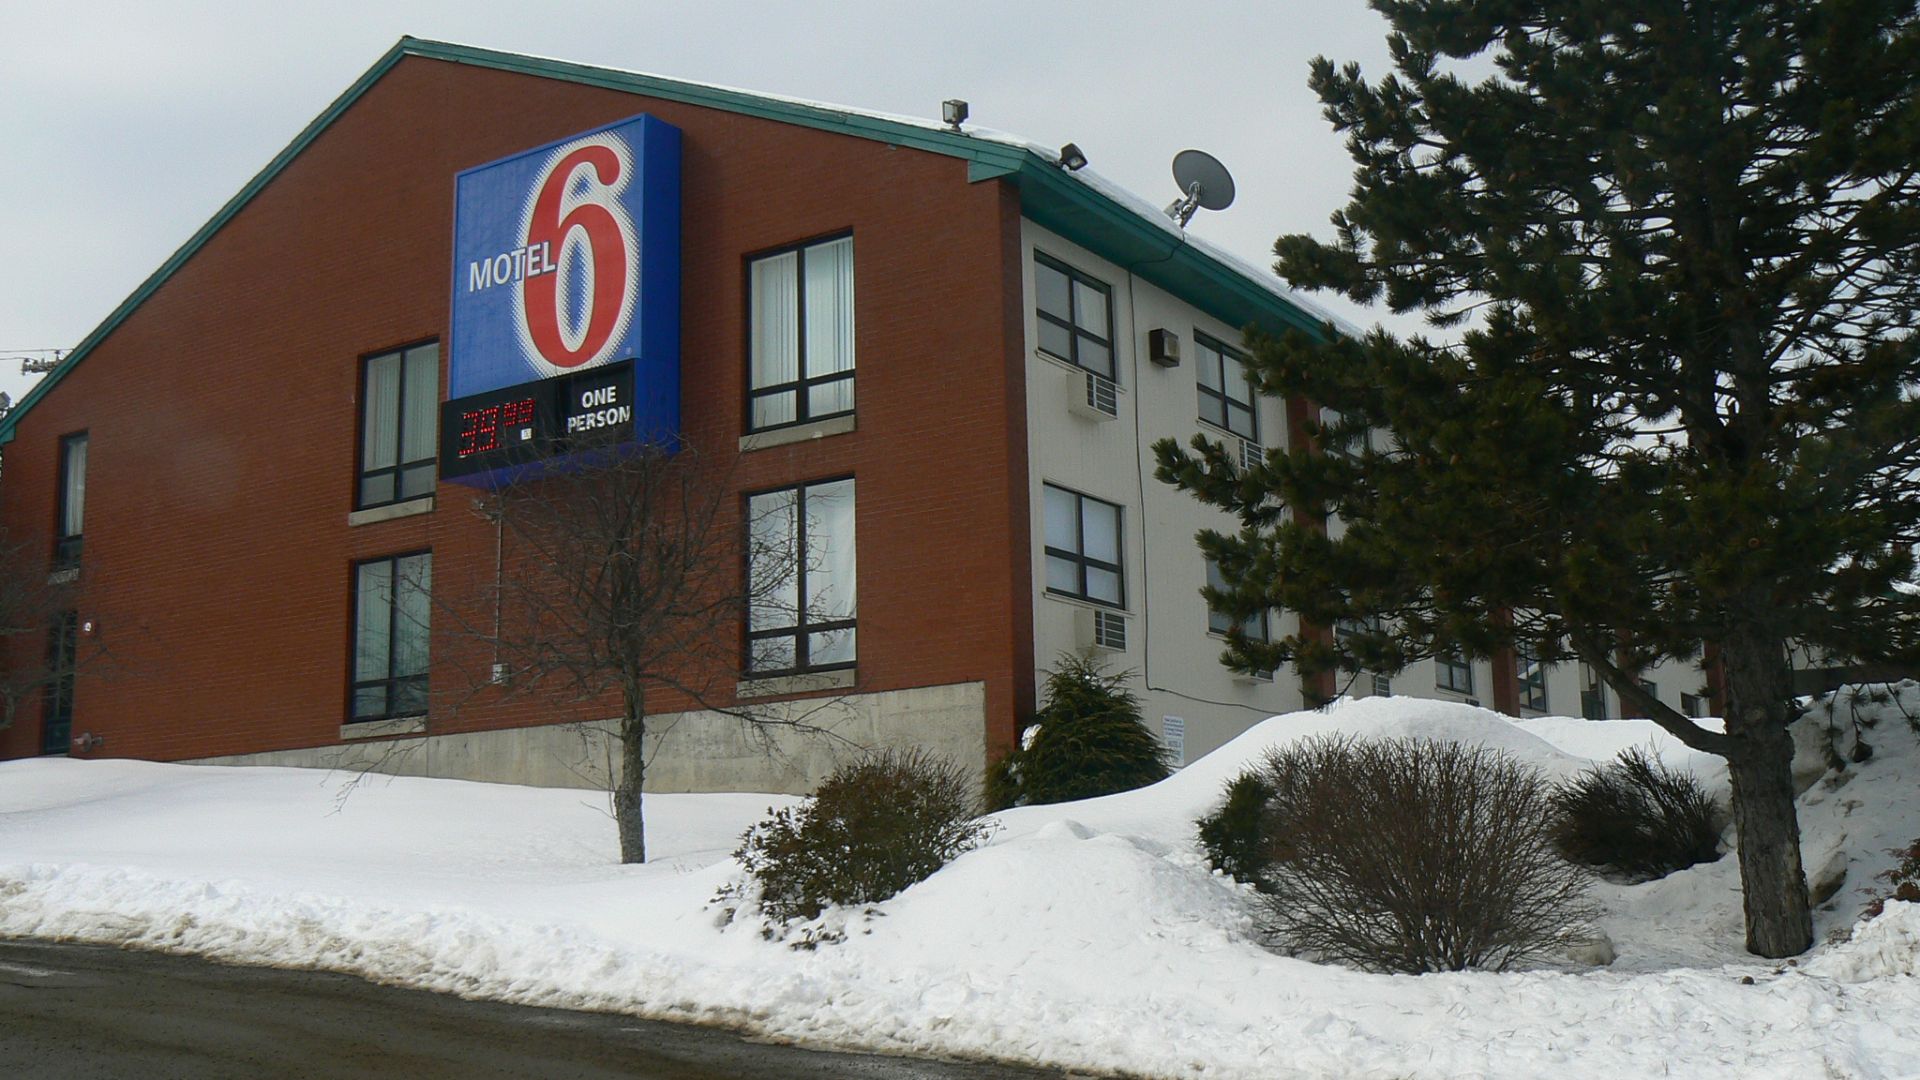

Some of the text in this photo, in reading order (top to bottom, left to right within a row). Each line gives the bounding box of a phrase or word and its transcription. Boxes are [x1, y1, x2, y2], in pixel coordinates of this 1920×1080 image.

[469, 145, 627, 367] MOTEL 6
[582, 385, 617, 409] ONE
[567, 405, 631, 434] PERSON
